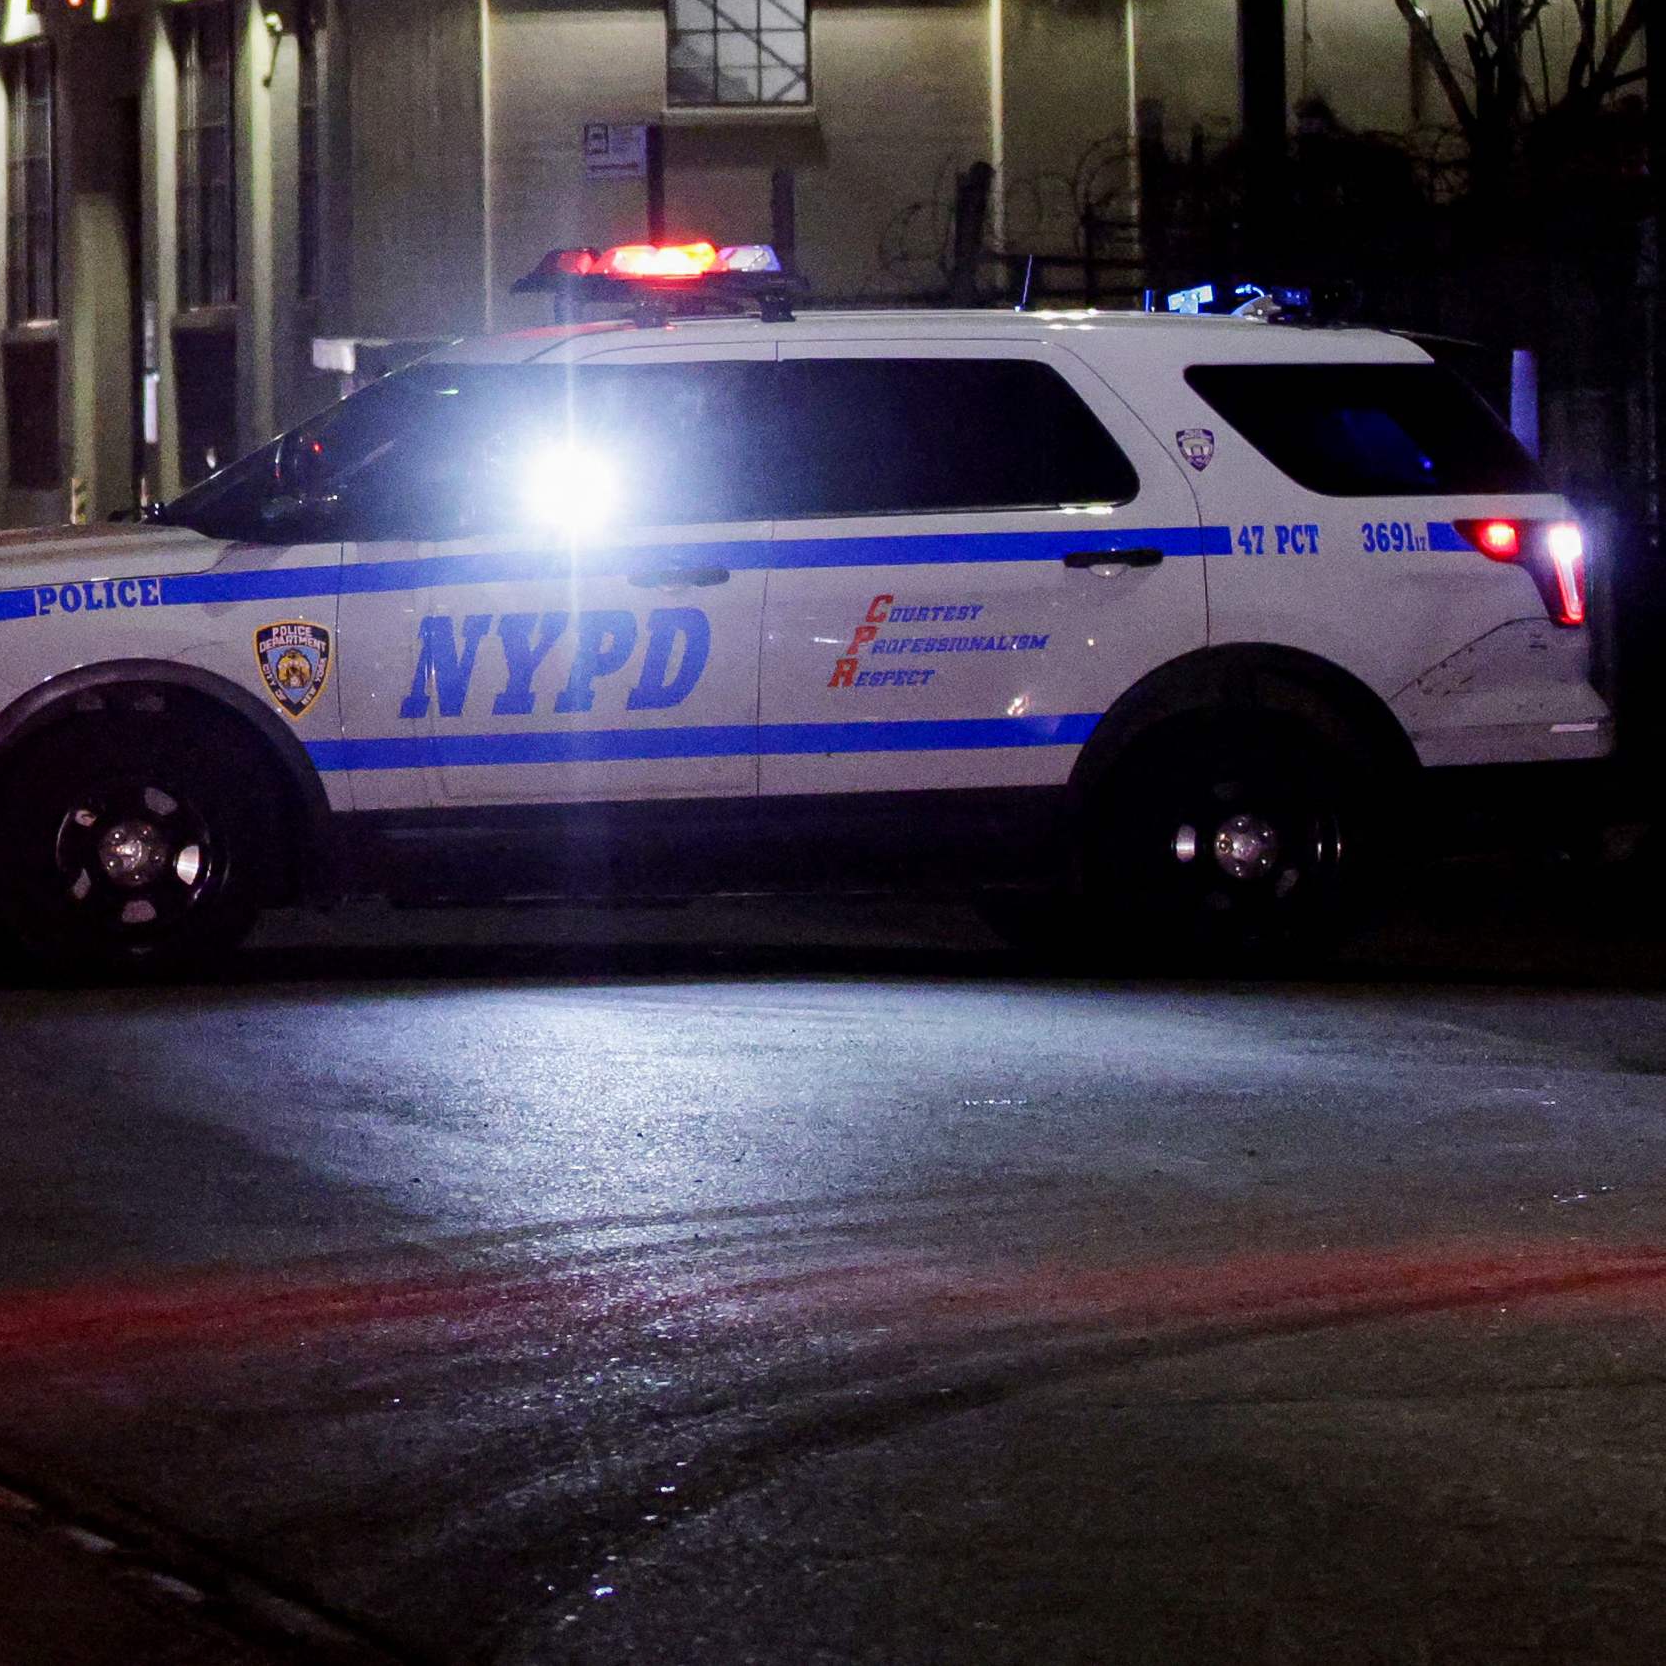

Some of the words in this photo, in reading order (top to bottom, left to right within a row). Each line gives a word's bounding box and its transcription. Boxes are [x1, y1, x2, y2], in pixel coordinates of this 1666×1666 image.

[1237, 525, 1265, 555] 47
[1274, 524, 1319, 555] PCT
[1361, 522, 1415, 553] 3691
[36, 579, 160, 615] POLICE
[865, 594, 984, 623] COURTESY
[258, 634, 328, 654] DEPARTMENT
[271, 625, 314, 638] POLICE
[846, 625, 1051, 655] PROFESSIONALISM
[398, 607, 711, 719] NYPD
[826, 658, 936, 688] RESPECT
